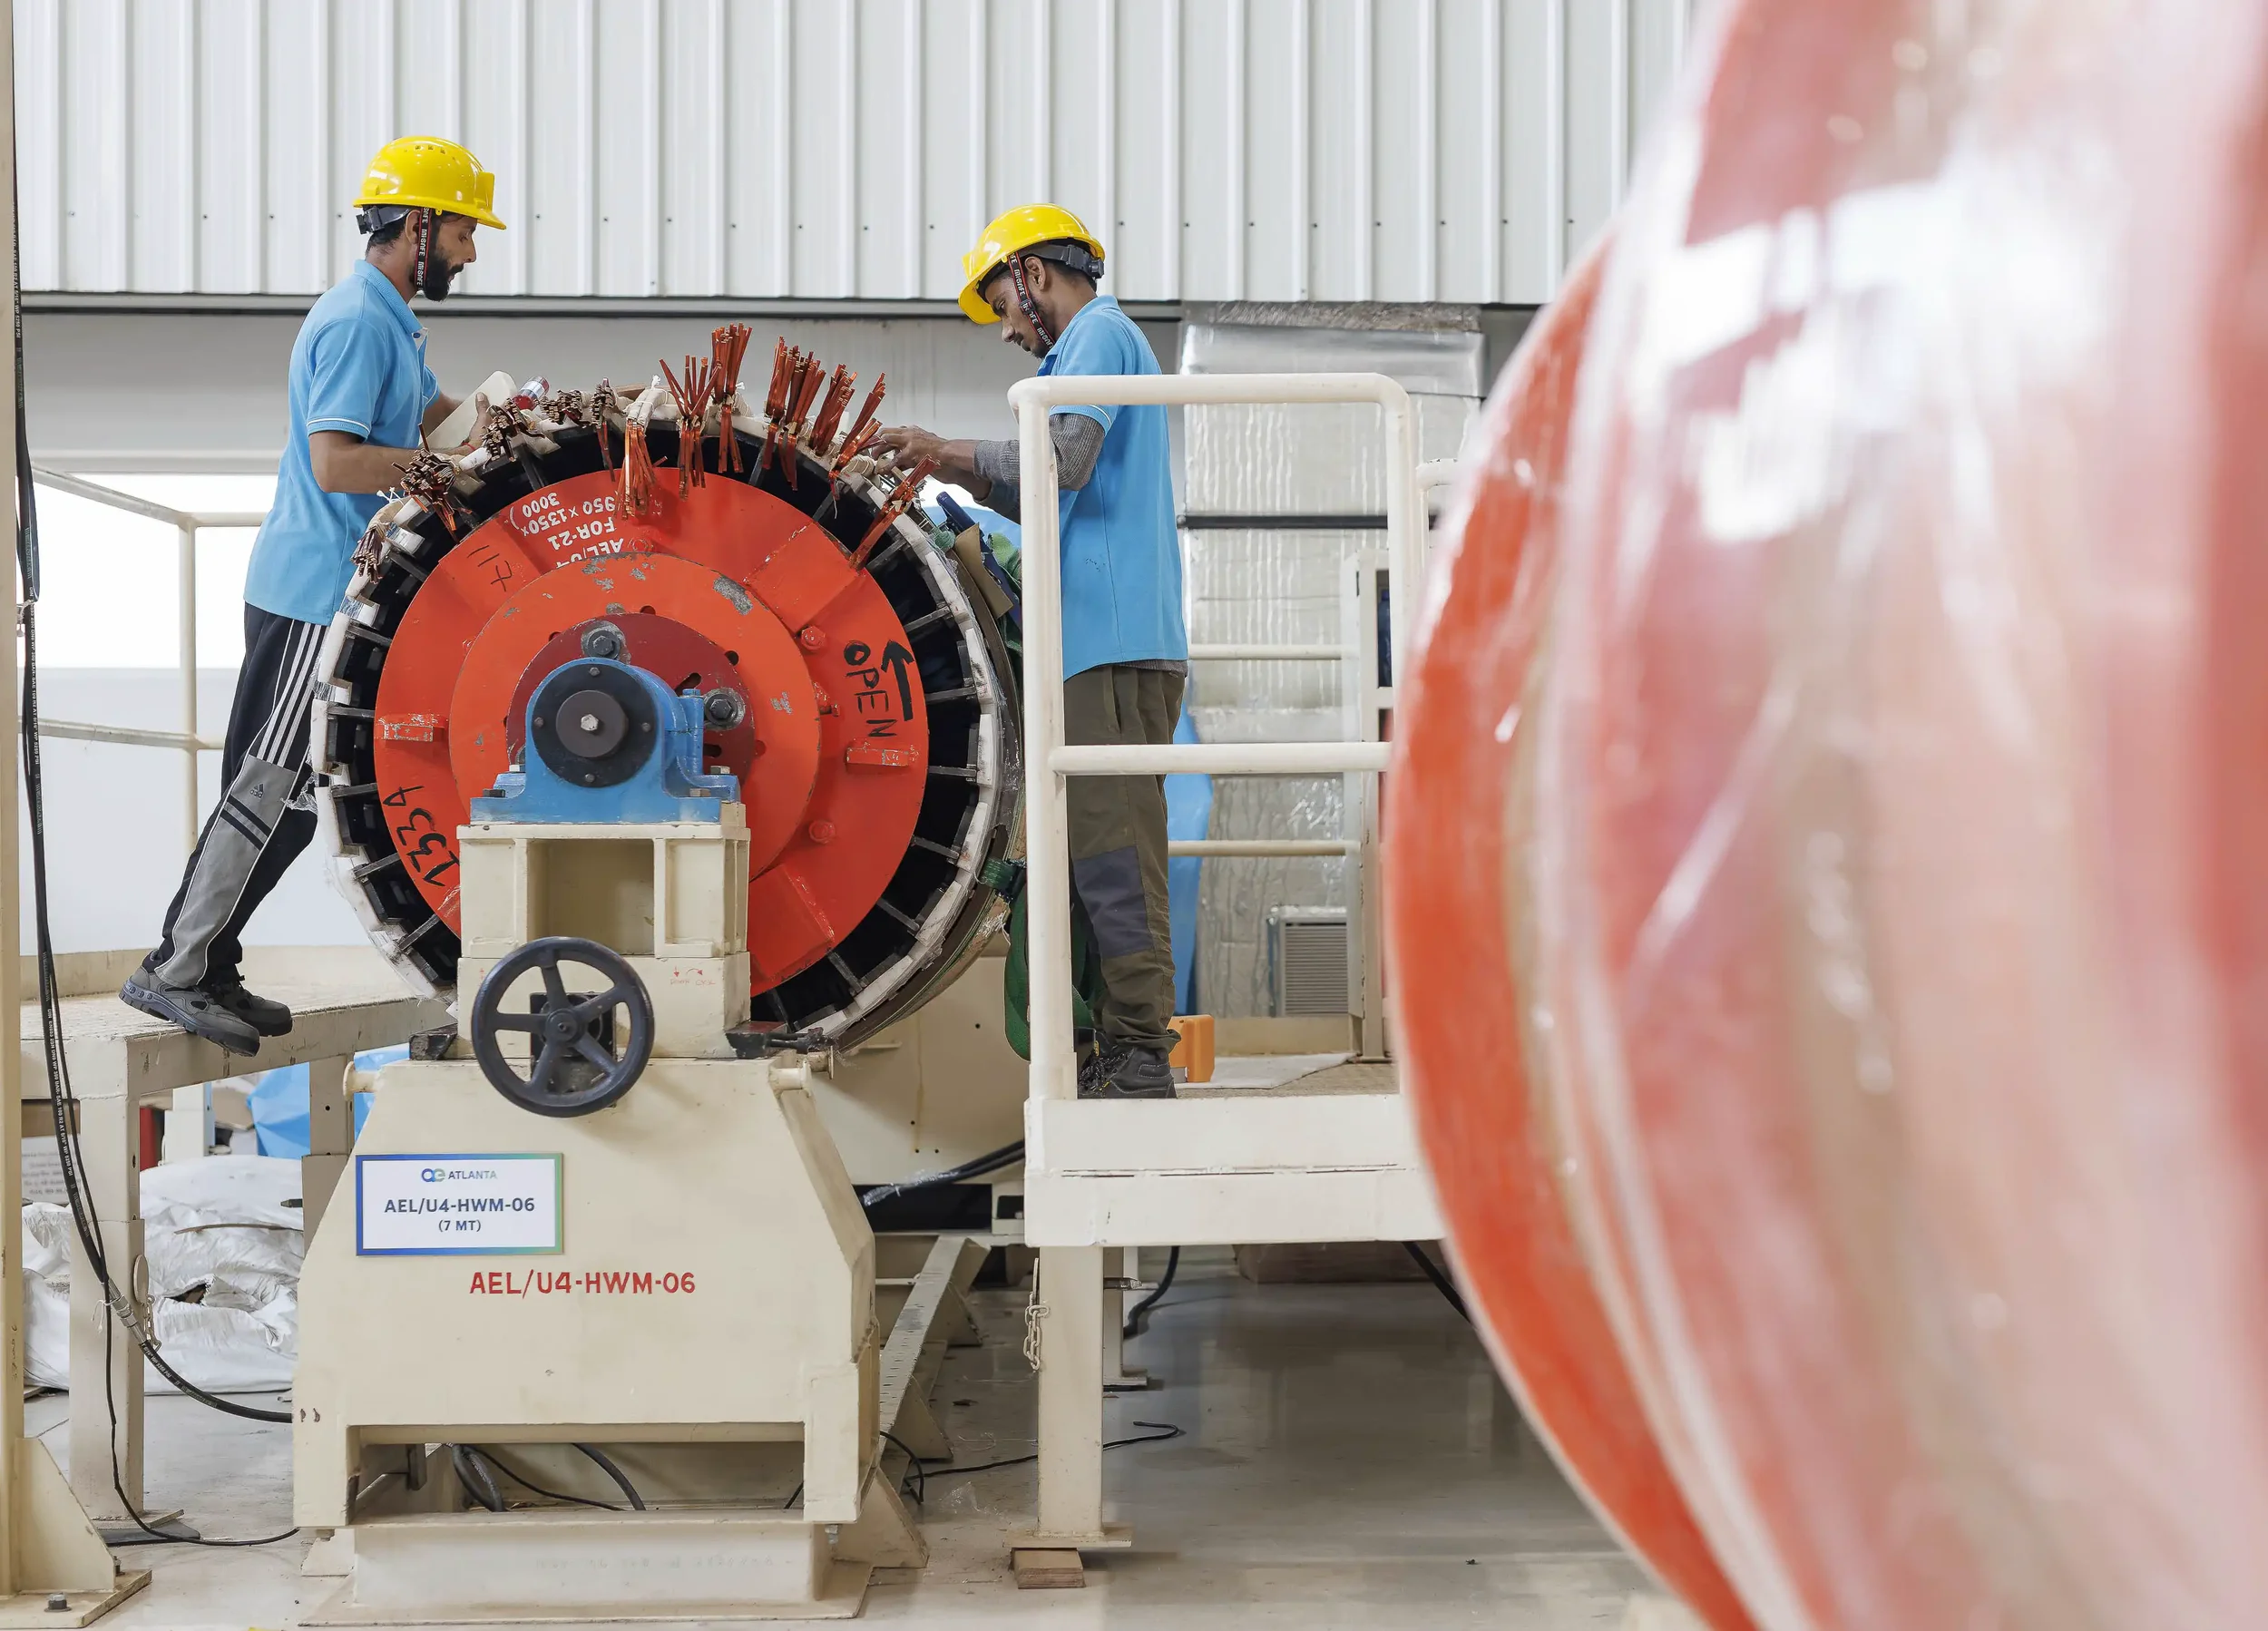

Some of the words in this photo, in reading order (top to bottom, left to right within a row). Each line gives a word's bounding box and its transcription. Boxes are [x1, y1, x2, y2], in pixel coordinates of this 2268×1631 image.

[844, 640, 897, 737] OPEN
[447, 1170, 498, 1180] ATLANTA
[384, 1197, 535, 1215] AEL/U4-HWM-06
[438, 1219, 451, 1233] (7
[455, 1219, 482, 1233] MT)
[469, 1269, 697, 1299] AEL/U4-HWM-06
